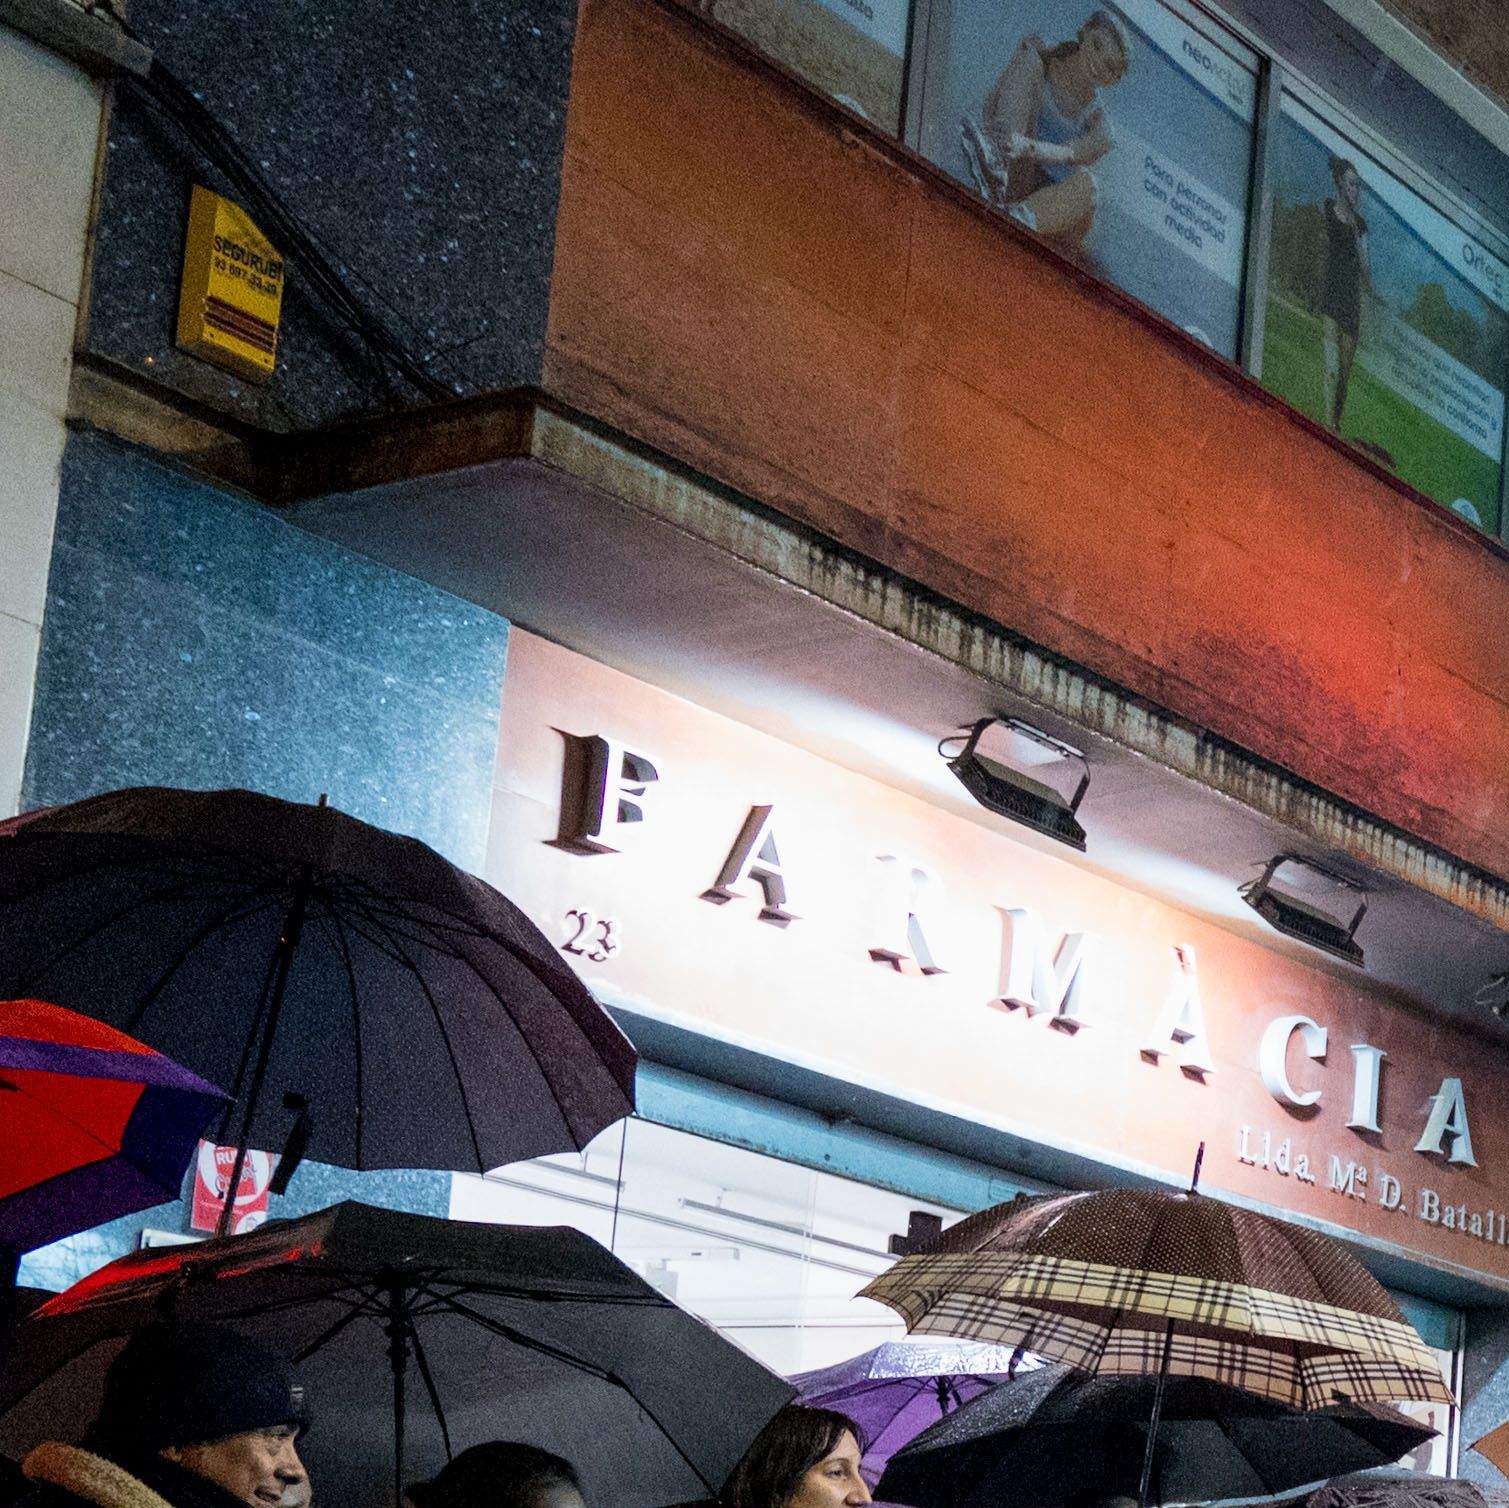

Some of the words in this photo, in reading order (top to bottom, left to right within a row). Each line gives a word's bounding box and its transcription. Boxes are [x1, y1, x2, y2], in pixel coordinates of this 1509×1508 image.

[1144, 156, 1174, 188] Para
[1143, 178, 1168, 204] con
[1169, 197, 1226, 244] actividad
[1164, 214, 1203, 250] media
[542, 727, 1480, 1168] FARMACIA
[561, 909, 620, 962] 23
[1238, 1124, 1316, 1185] Llda.
[1378, 1173, 1408, 1212] D.
